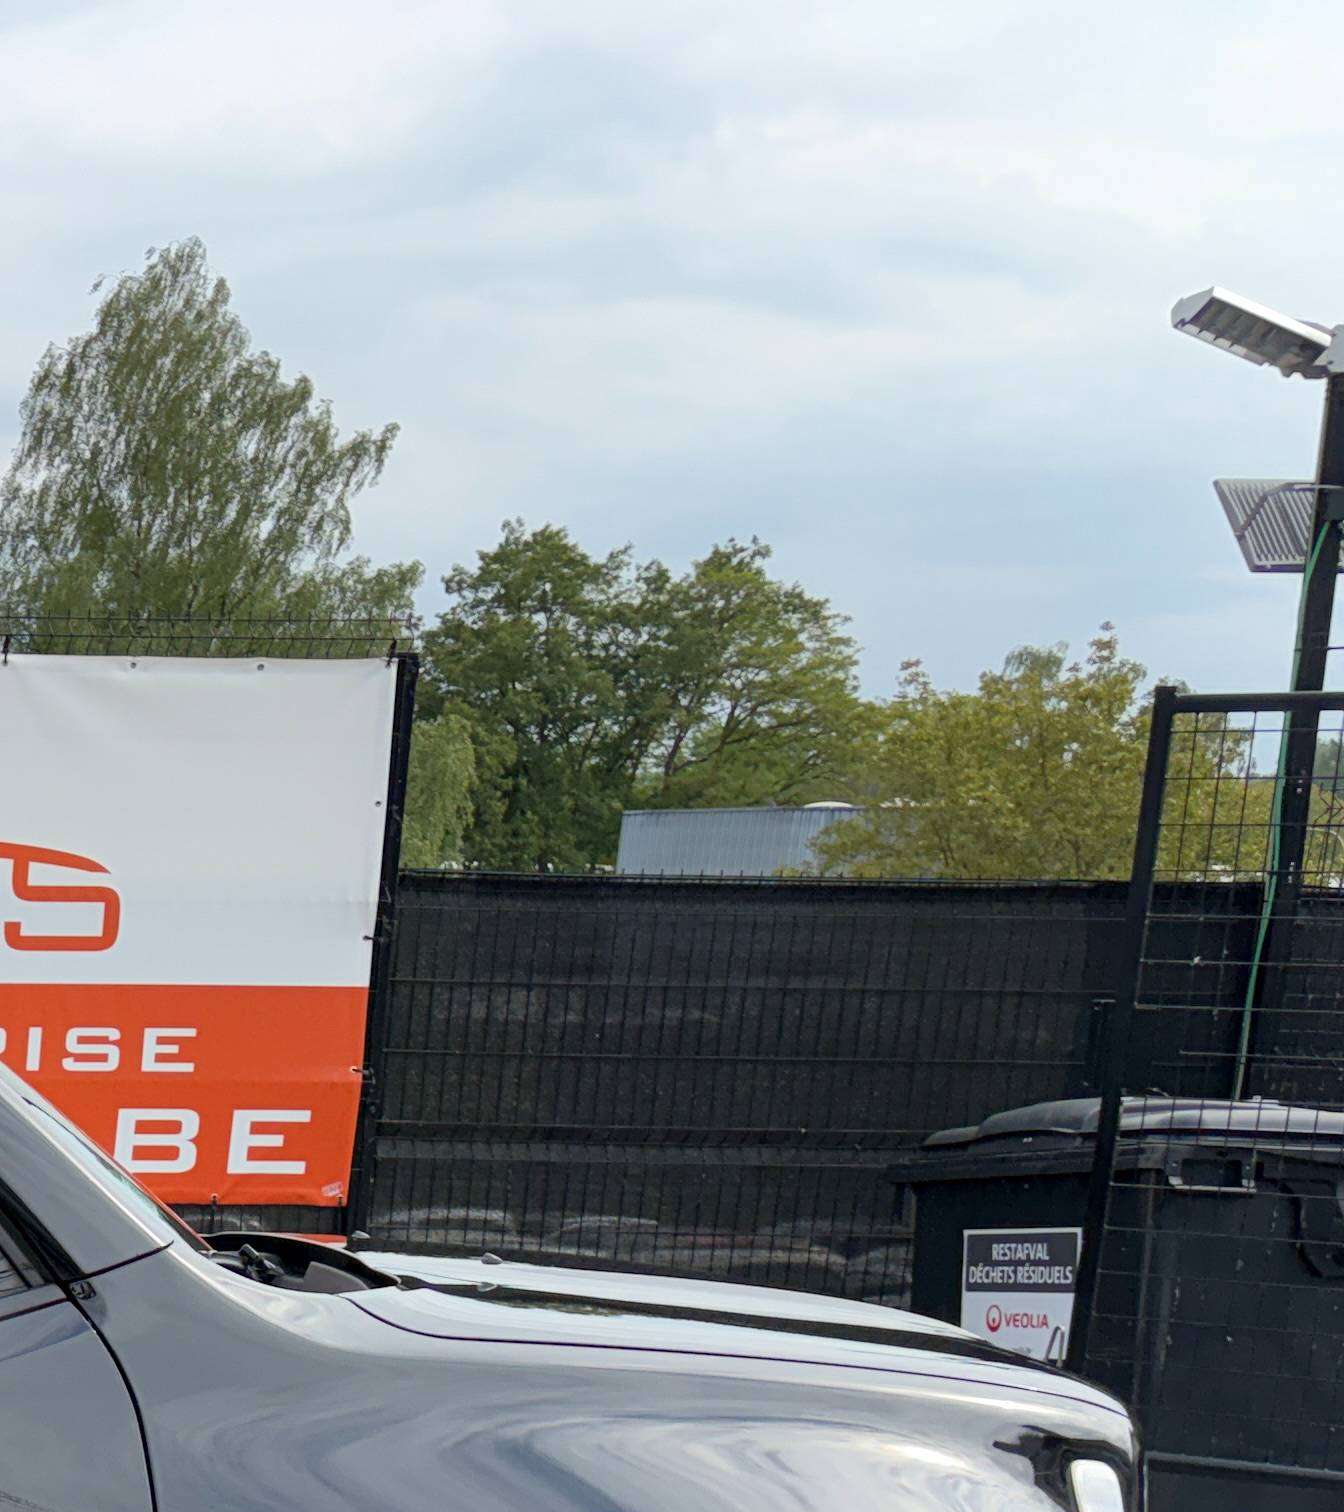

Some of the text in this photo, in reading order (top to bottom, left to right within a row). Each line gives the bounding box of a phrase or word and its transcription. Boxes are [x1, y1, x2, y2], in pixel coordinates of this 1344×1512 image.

[991, 1242, 1050, 1261] RESTAFVAL
[968, 1262, 1073, 1285] DÉCHETS RÉSIDUELS
[1004, 1312, 1050, 1329] VEOLIA
